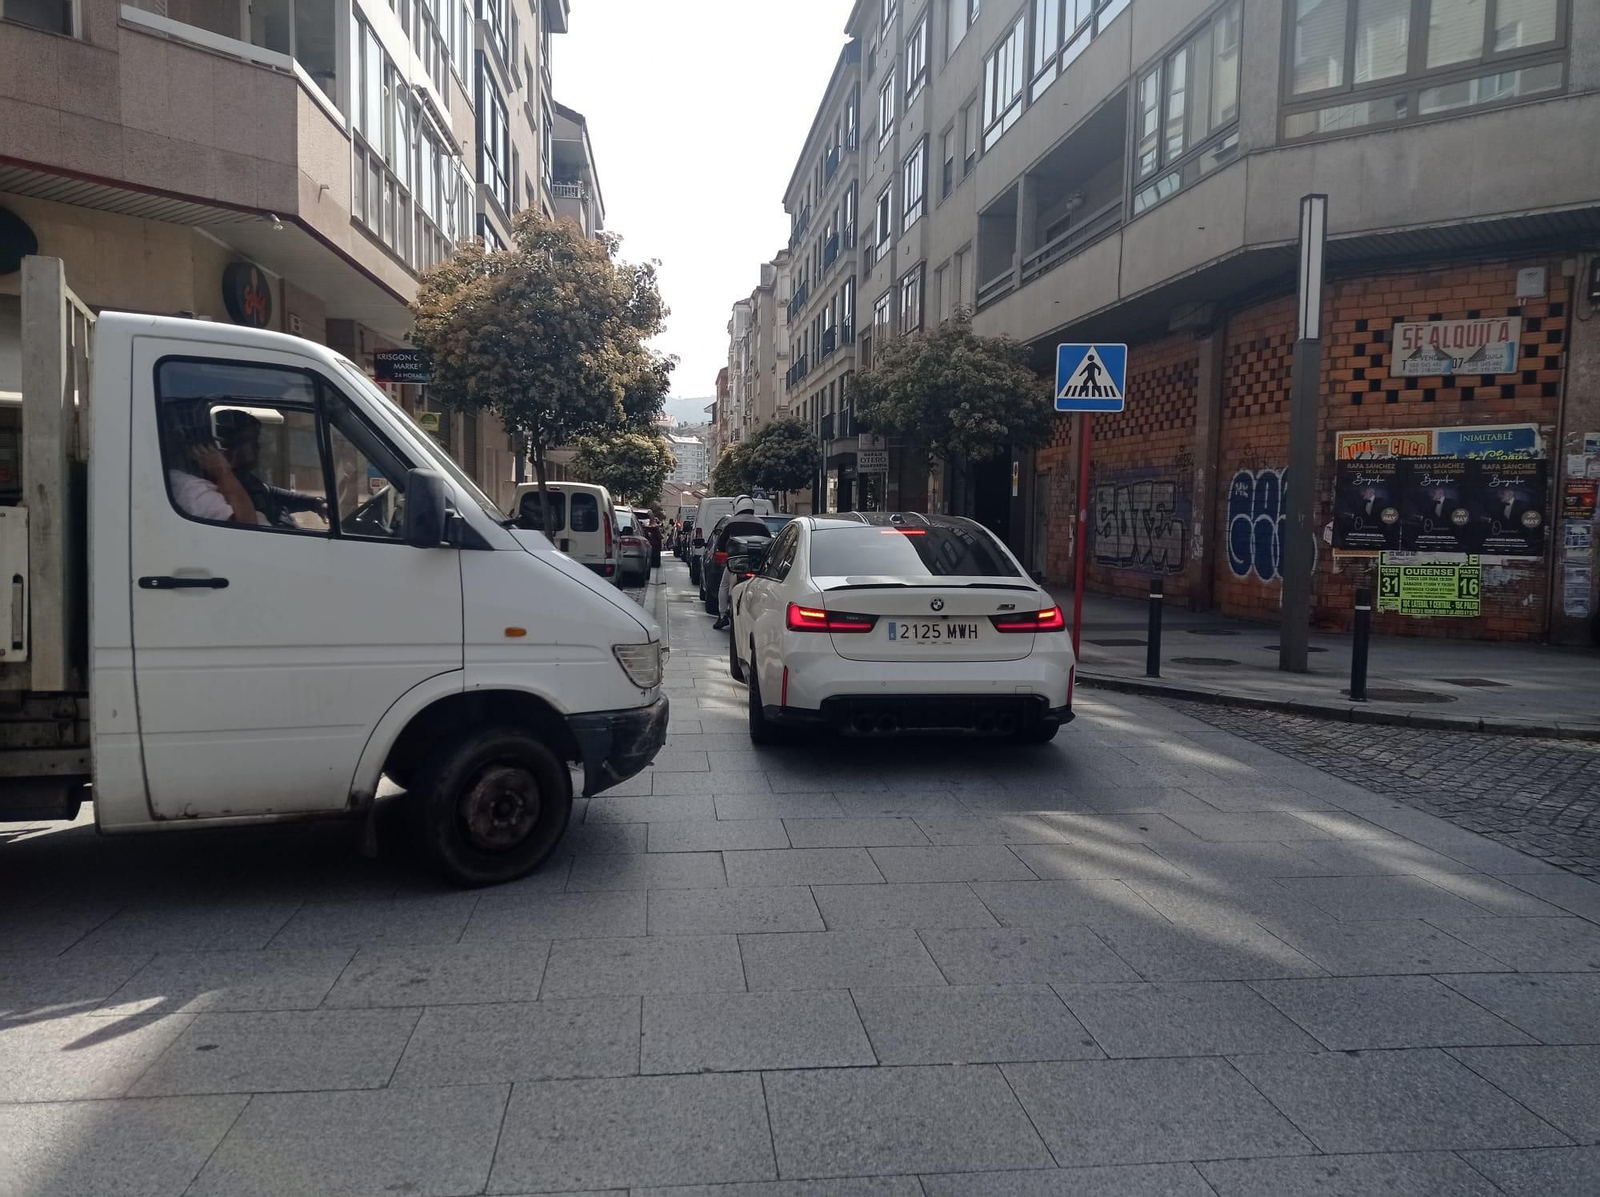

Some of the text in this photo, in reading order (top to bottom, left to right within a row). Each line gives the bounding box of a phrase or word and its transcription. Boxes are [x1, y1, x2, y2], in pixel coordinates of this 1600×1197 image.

[1402, 322, 1509, 350] SE ALQUILA
[377, 353, 411, 361] KRISGON
[1391, 438, 1426, 457] CIRCO
[1405, 568, 1454, 576] OURENSE
[1382, 577, 1398, 593] 31
[1460, 578, 1479, 595] 16
[900, 624, 978, 639] 2125 MWH
